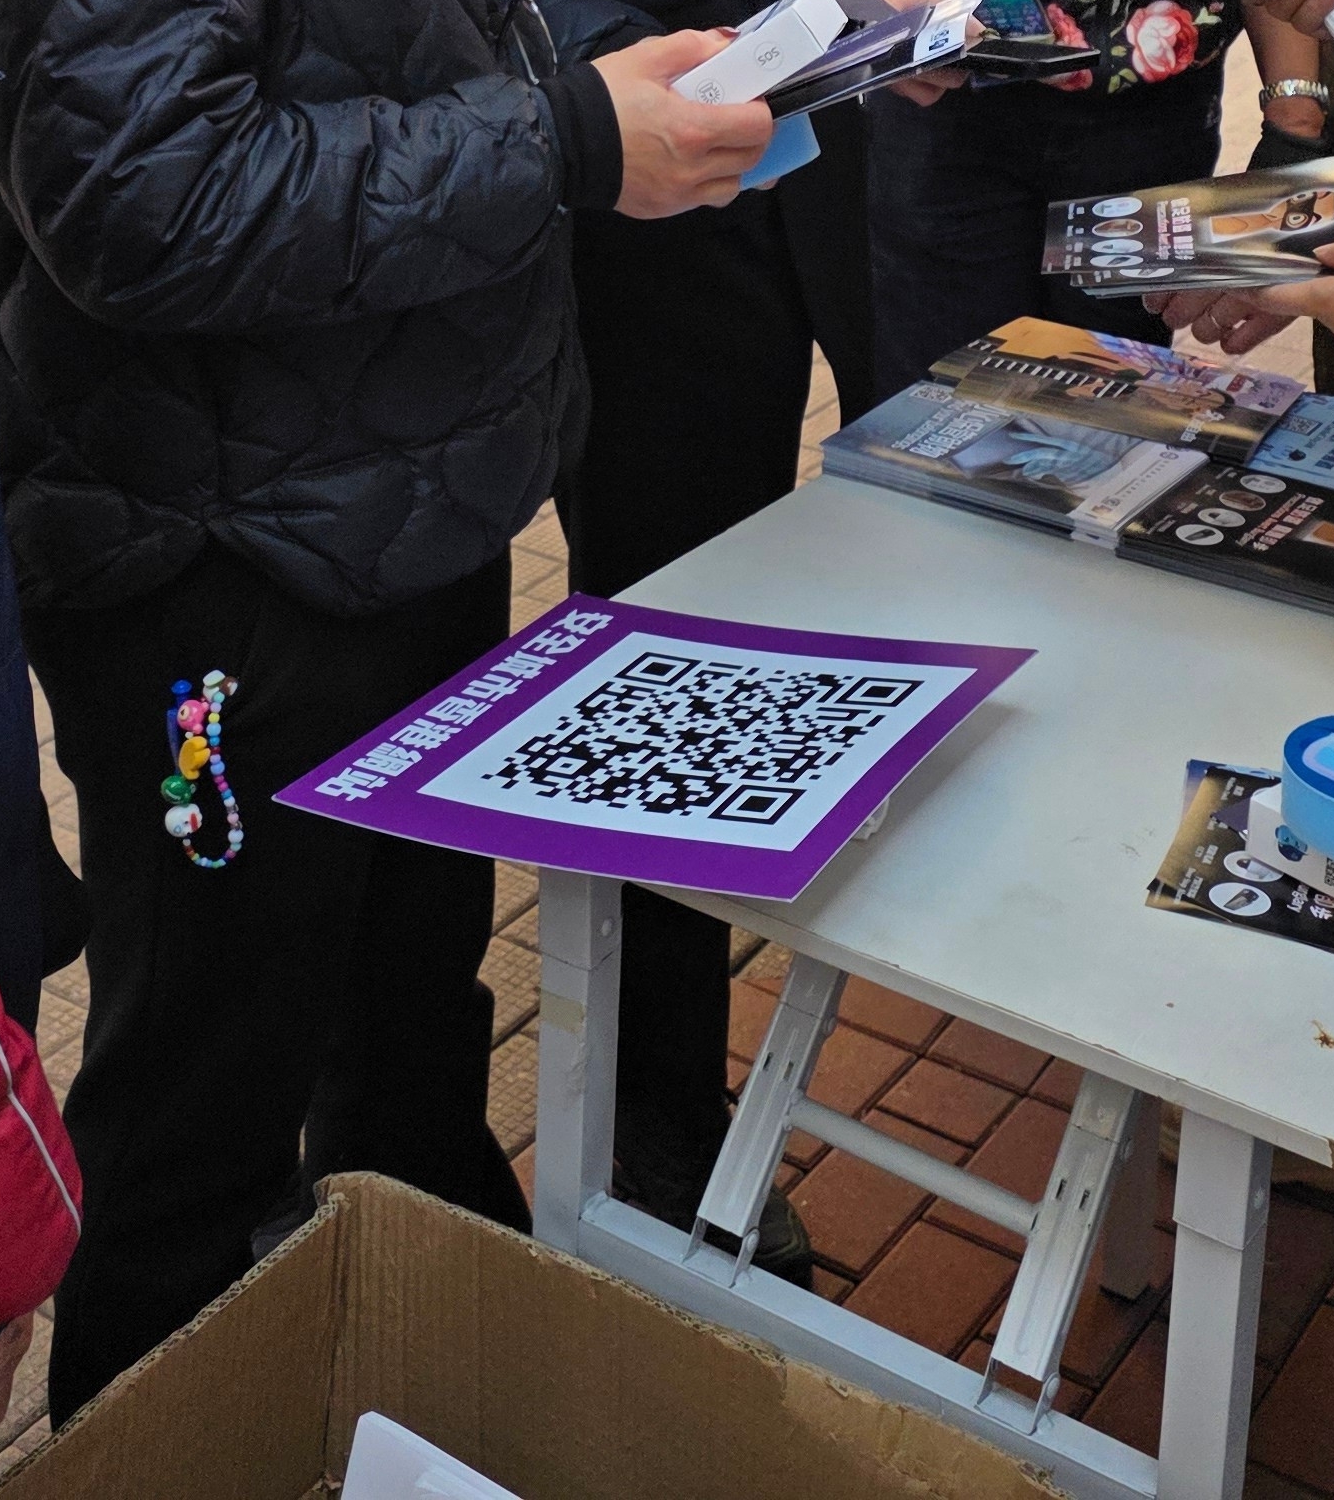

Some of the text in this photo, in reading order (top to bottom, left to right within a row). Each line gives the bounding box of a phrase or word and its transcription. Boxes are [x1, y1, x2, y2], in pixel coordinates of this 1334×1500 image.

[313, 608, 615, 803] 安全城市香港網站
